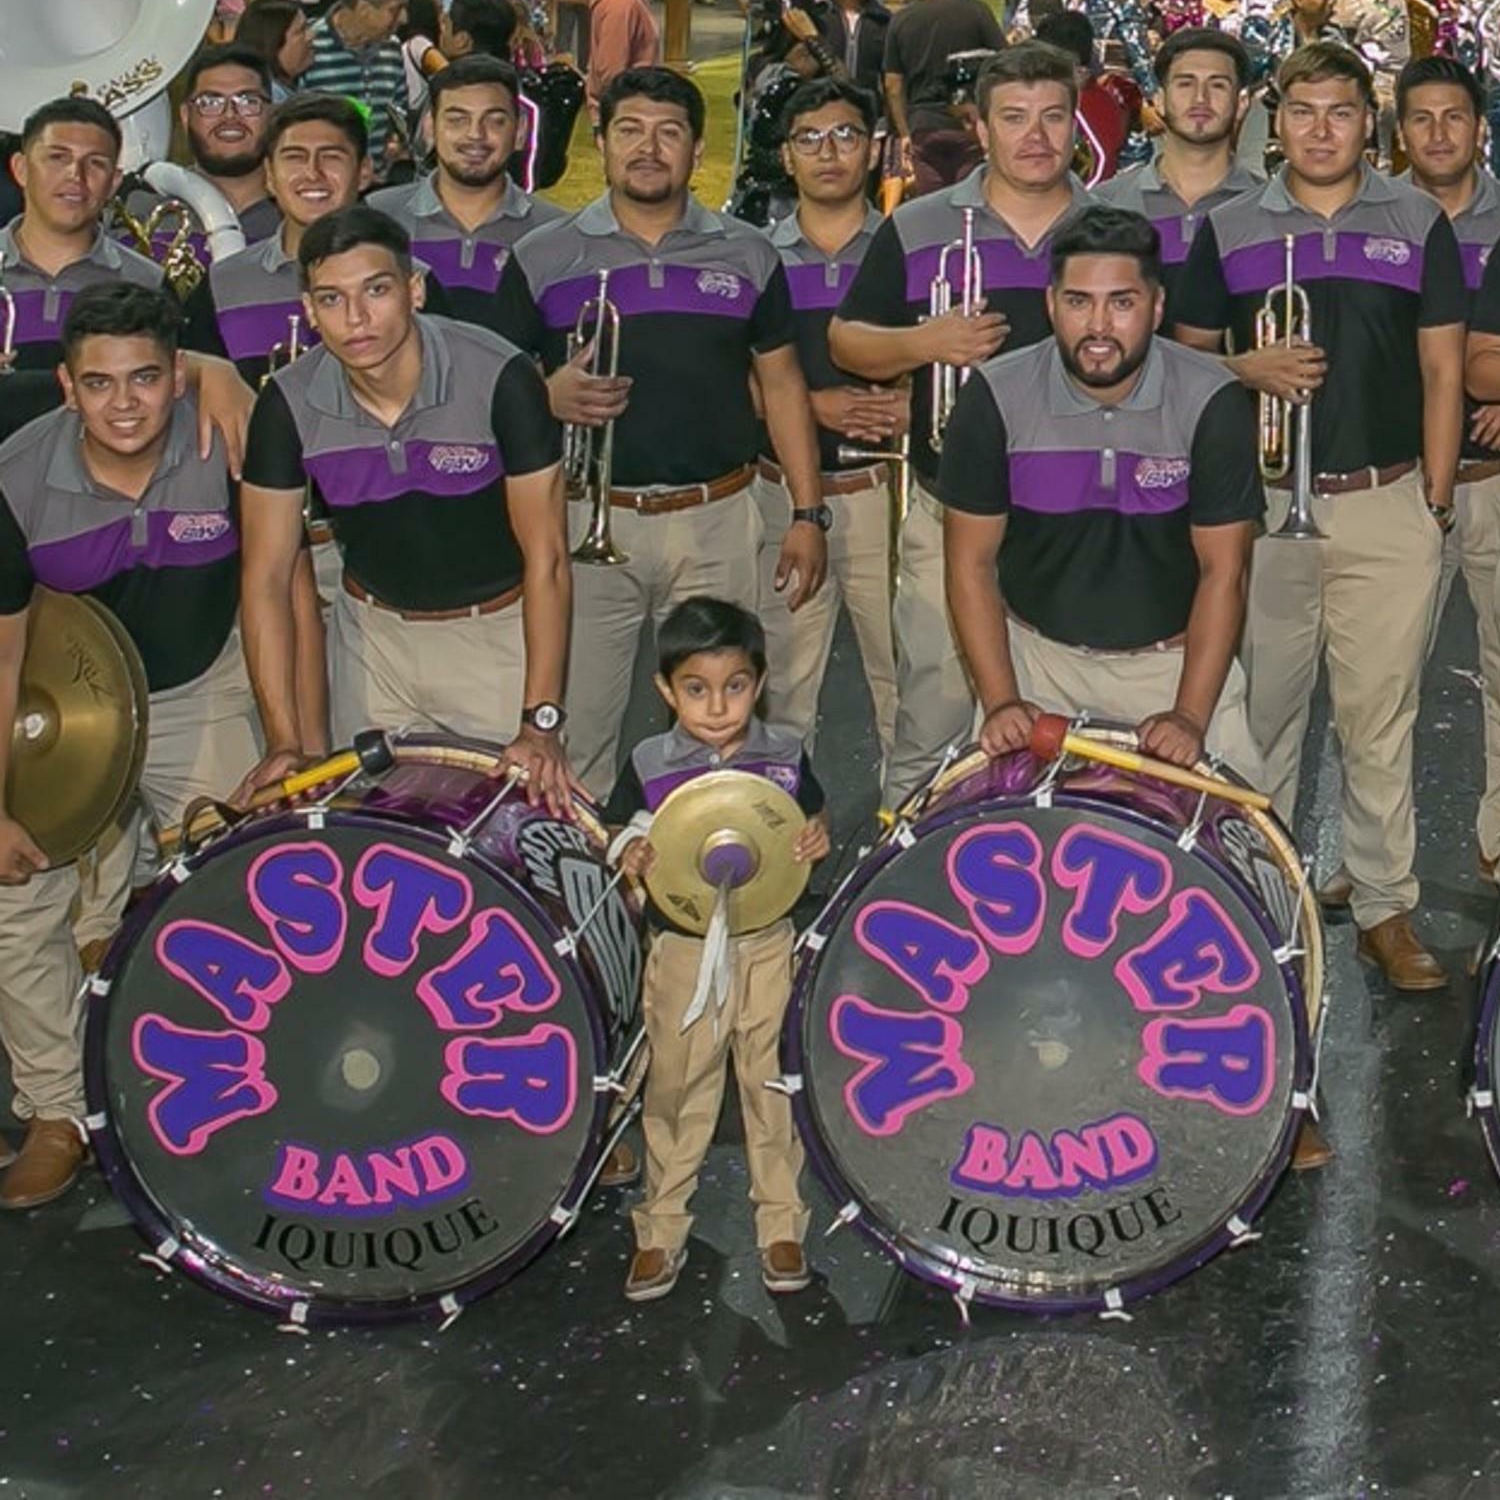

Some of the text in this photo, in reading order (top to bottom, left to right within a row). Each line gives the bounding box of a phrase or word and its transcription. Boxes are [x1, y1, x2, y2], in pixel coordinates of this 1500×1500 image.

[517, 820, 592, 898] MASTER
[132, 841, 577, 1156] MASTER
[829, 822, 1275, 1137] MASTER
[268, 1136, 469, 1215] BAND
[954, 1114, 1157, 1194] BAND
[252, 1197, 500, 1271] IQUIQUE
[936, 1188, 1182, 1255] IQUIQUE
